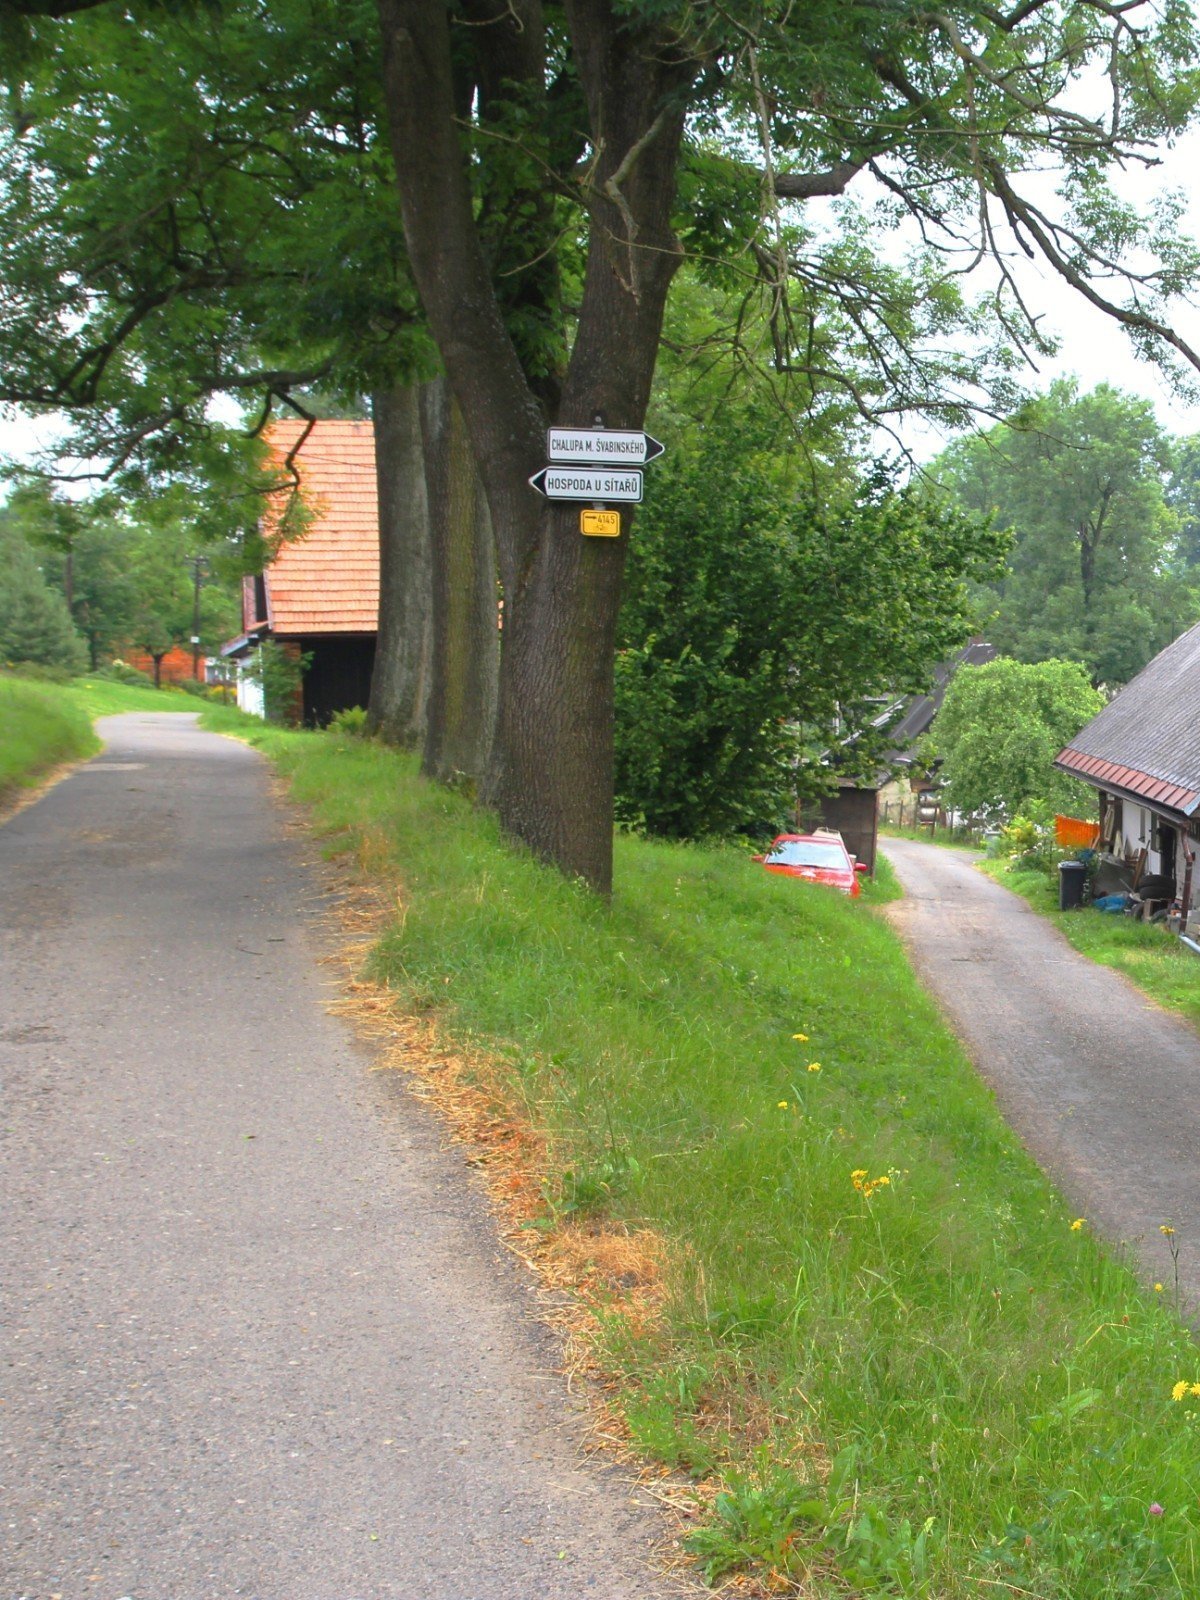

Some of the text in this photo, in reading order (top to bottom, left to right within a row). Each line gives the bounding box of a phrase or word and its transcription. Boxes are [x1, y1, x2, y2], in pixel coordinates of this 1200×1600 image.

[551, 438, 644, 454] CHALUPA M. ŠVABINSKÉHO
[548, 477, 638, 493] HOSPODA U SÍTAŘŮ
[597, 514, 615, 525] 4145
